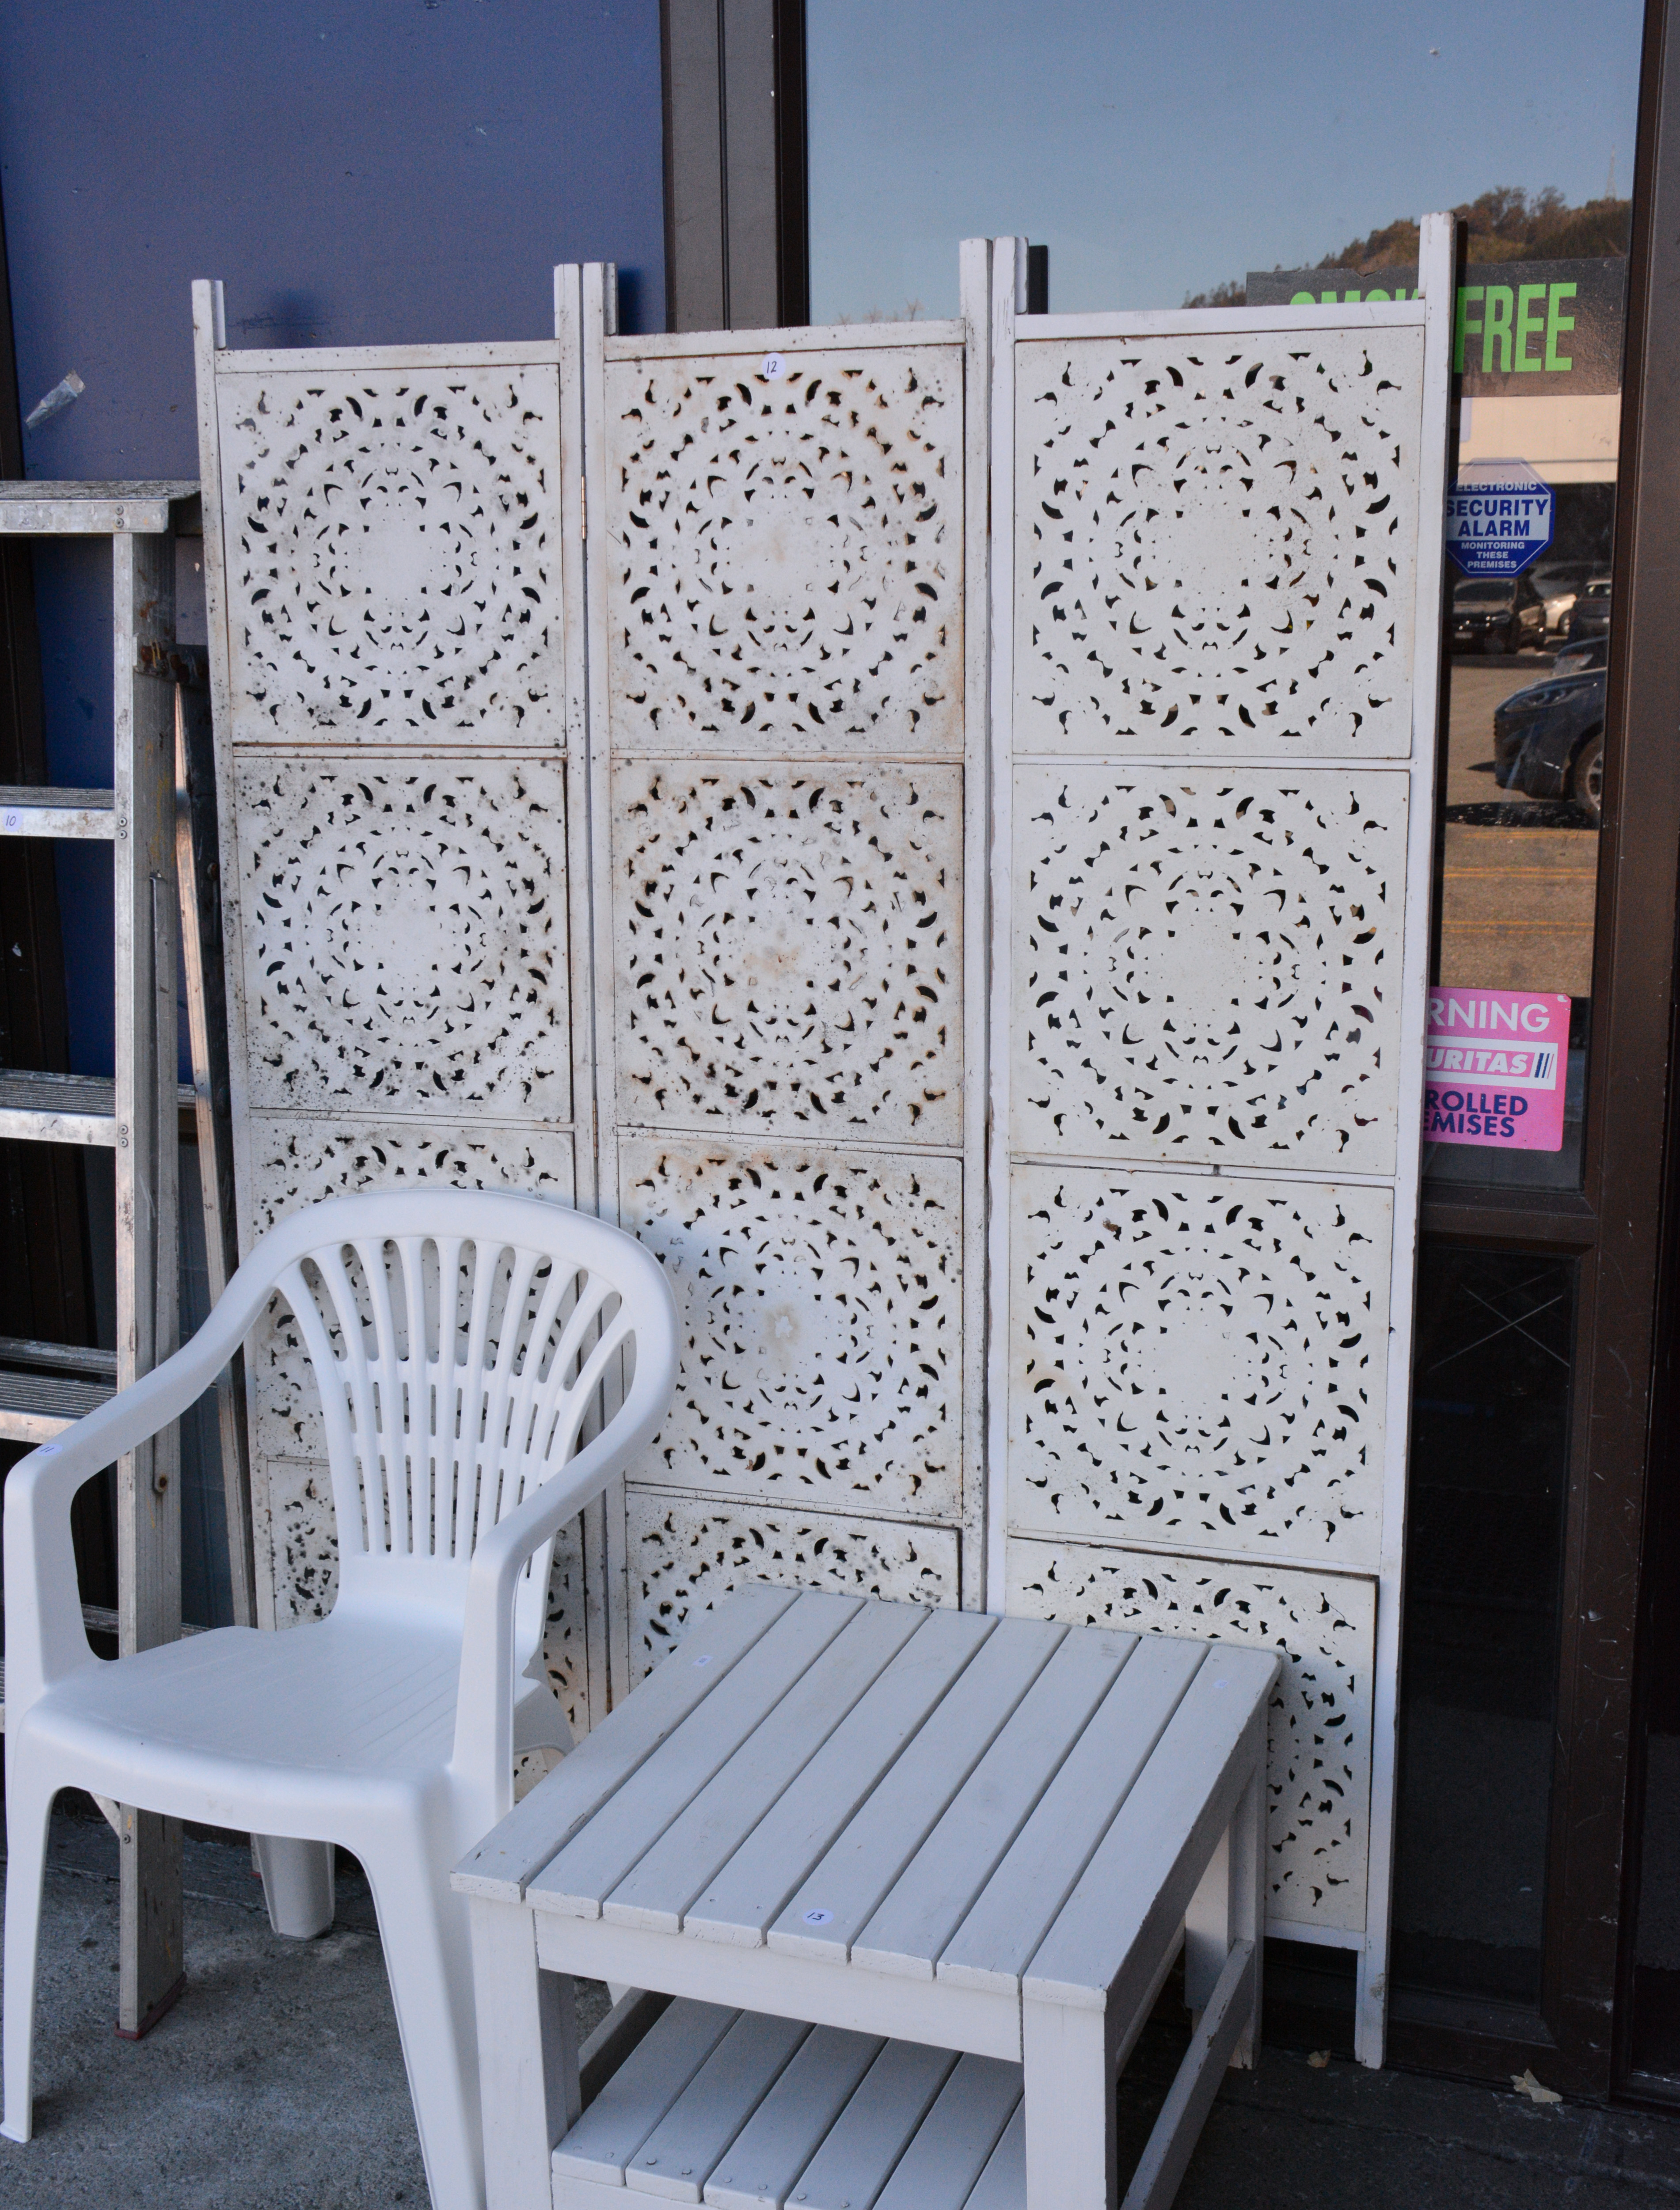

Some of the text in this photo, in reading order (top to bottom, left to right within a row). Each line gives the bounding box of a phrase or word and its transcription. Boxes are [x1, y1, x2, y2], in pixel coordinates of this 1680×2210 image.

[1453, 282, 1577, 373] FREE
[767, 361, 777, 374] 12
[1455, 481, 1537, 492] ELECTRONIC
[1446, 499, 1548, 517] SECURITY
[1458, 519, 1530, 537] ALARM
[6, 815, 16, 826] 10
[807, 1912, 825, 1920] 13
